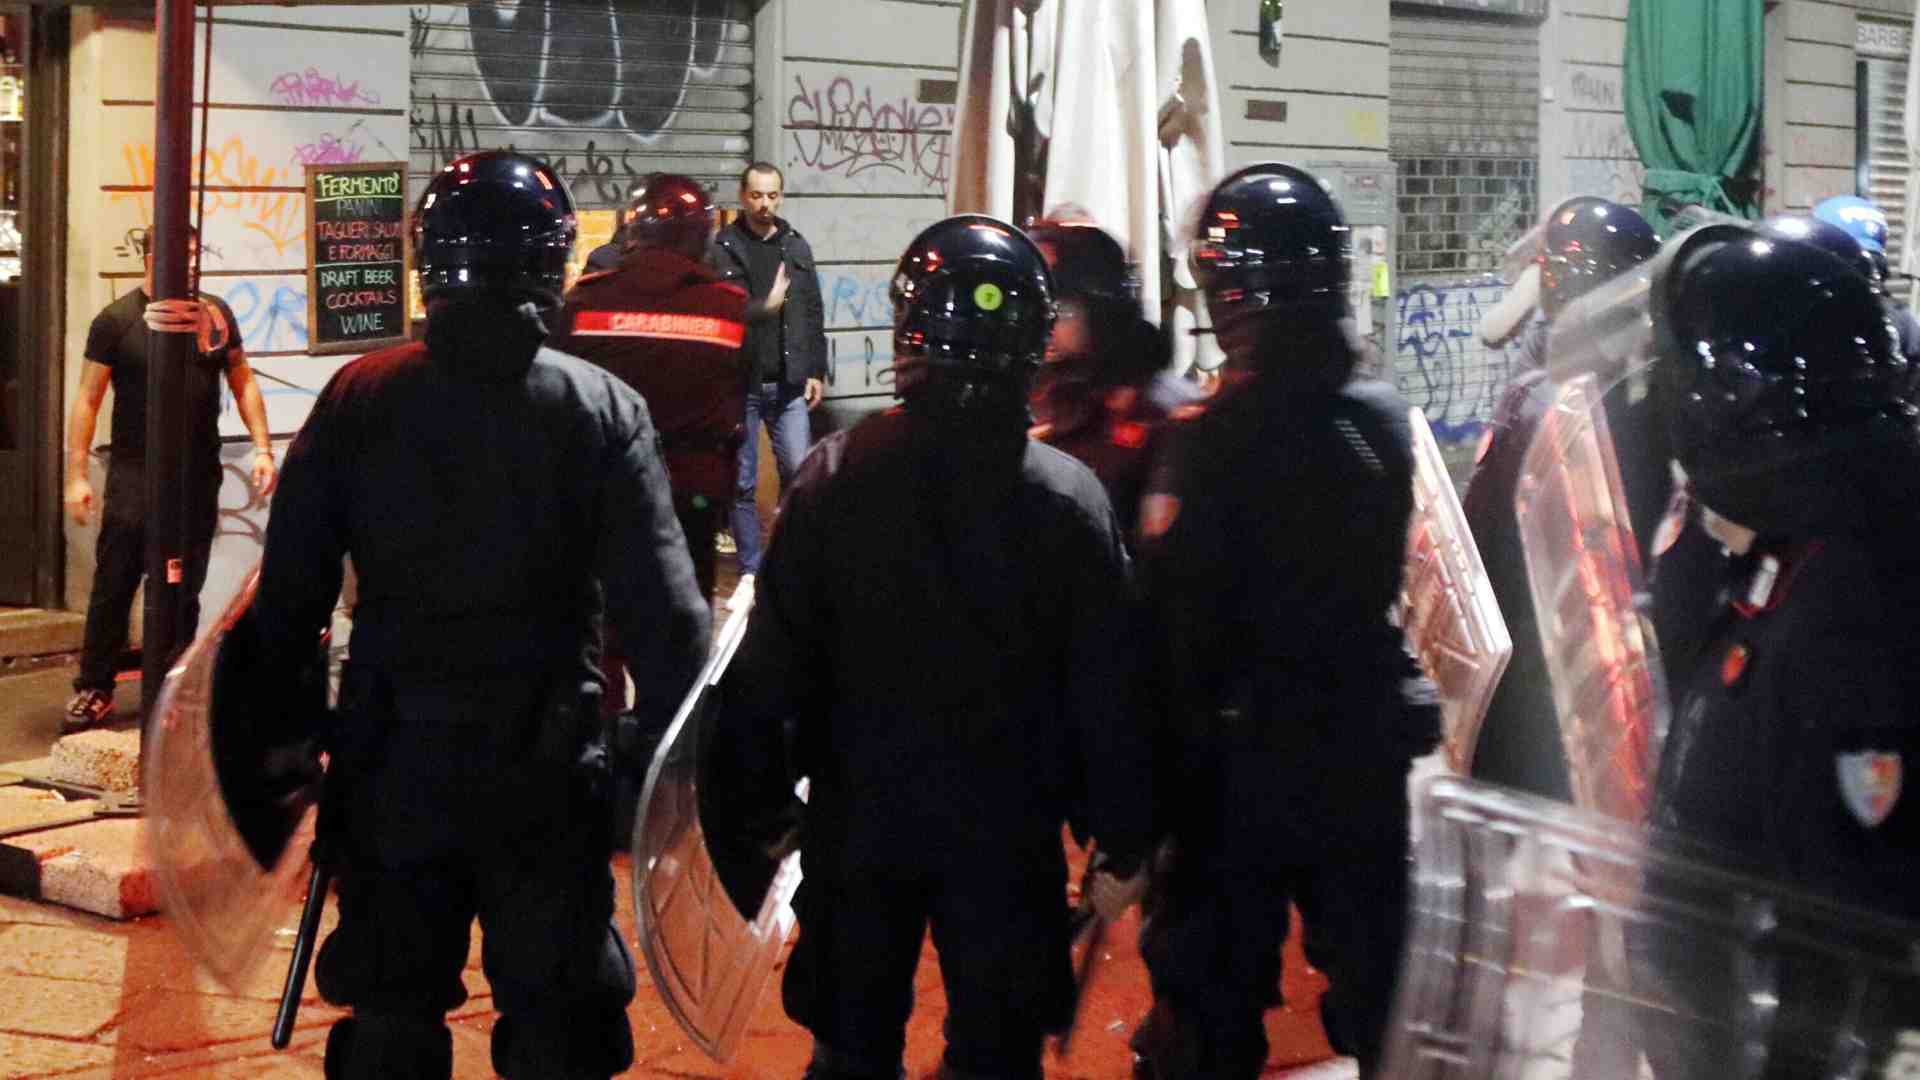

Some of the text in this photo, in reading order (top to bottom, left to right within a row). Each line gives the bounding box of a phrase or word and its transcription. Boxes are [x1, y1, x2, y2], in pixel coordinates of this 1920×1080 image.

[321, 269, 396, 288] DRAFT BEER
[326, 290, 396, 310] COCKTAILS
[340, 312, 384, 335] WINE
